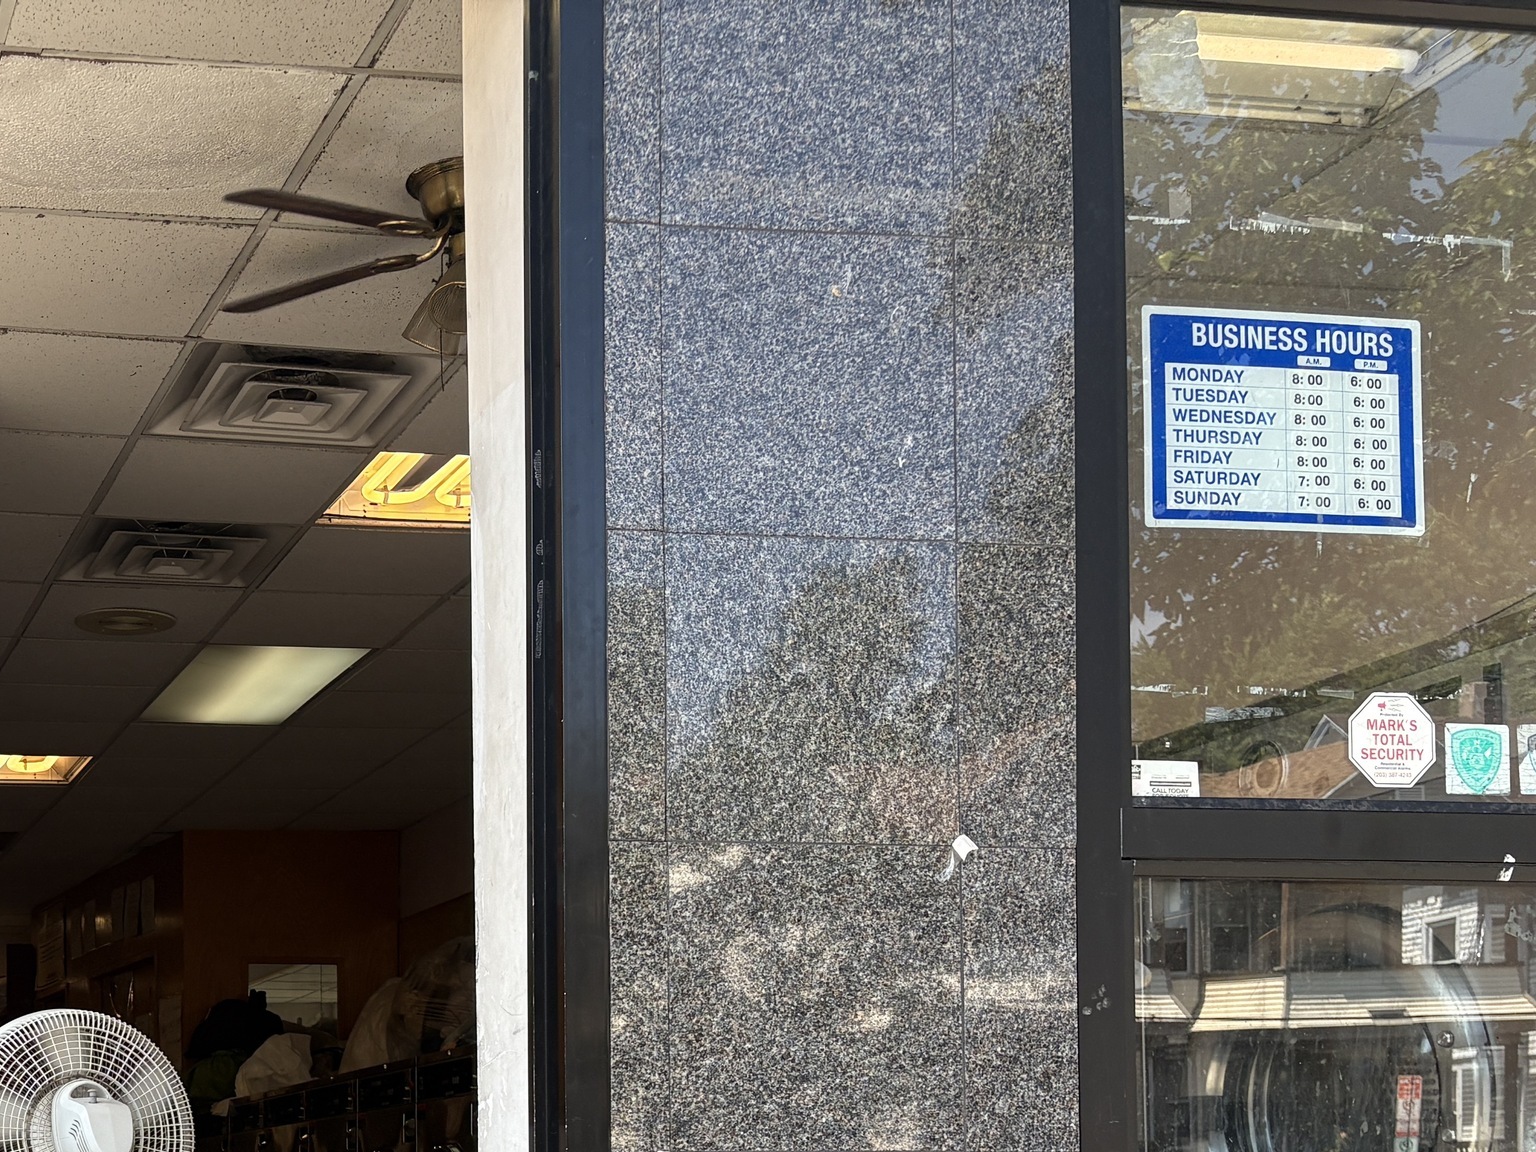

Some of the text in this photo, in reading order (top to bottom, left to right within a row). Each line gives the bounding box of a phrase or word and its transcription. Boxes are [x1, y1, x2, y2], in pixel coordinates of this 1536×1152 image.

[1192, 322, 1394, 357] BUSINESS HOURS
[1172, 366, 1245, 383] MONDAY
[1172, 388, 1248, 404] TUESDAY
[1294, 393, 1323, 406] 8:00
[1172, 408, 1277, 425] WEDNESDAY
[1172, 429, 1263, 445] THURSDAY
[1173, 449, 1233, 465] FRIDAY
[1173, 470, 1261, 486] SATURDAY
[1173, 490, 1242, 506] SUNDAY
[1366, 718, 1417, 731] MARK'S
[1372, 733, 1412, 746] TOTAL
[1360, 747, 1424, 761] SECURITY
